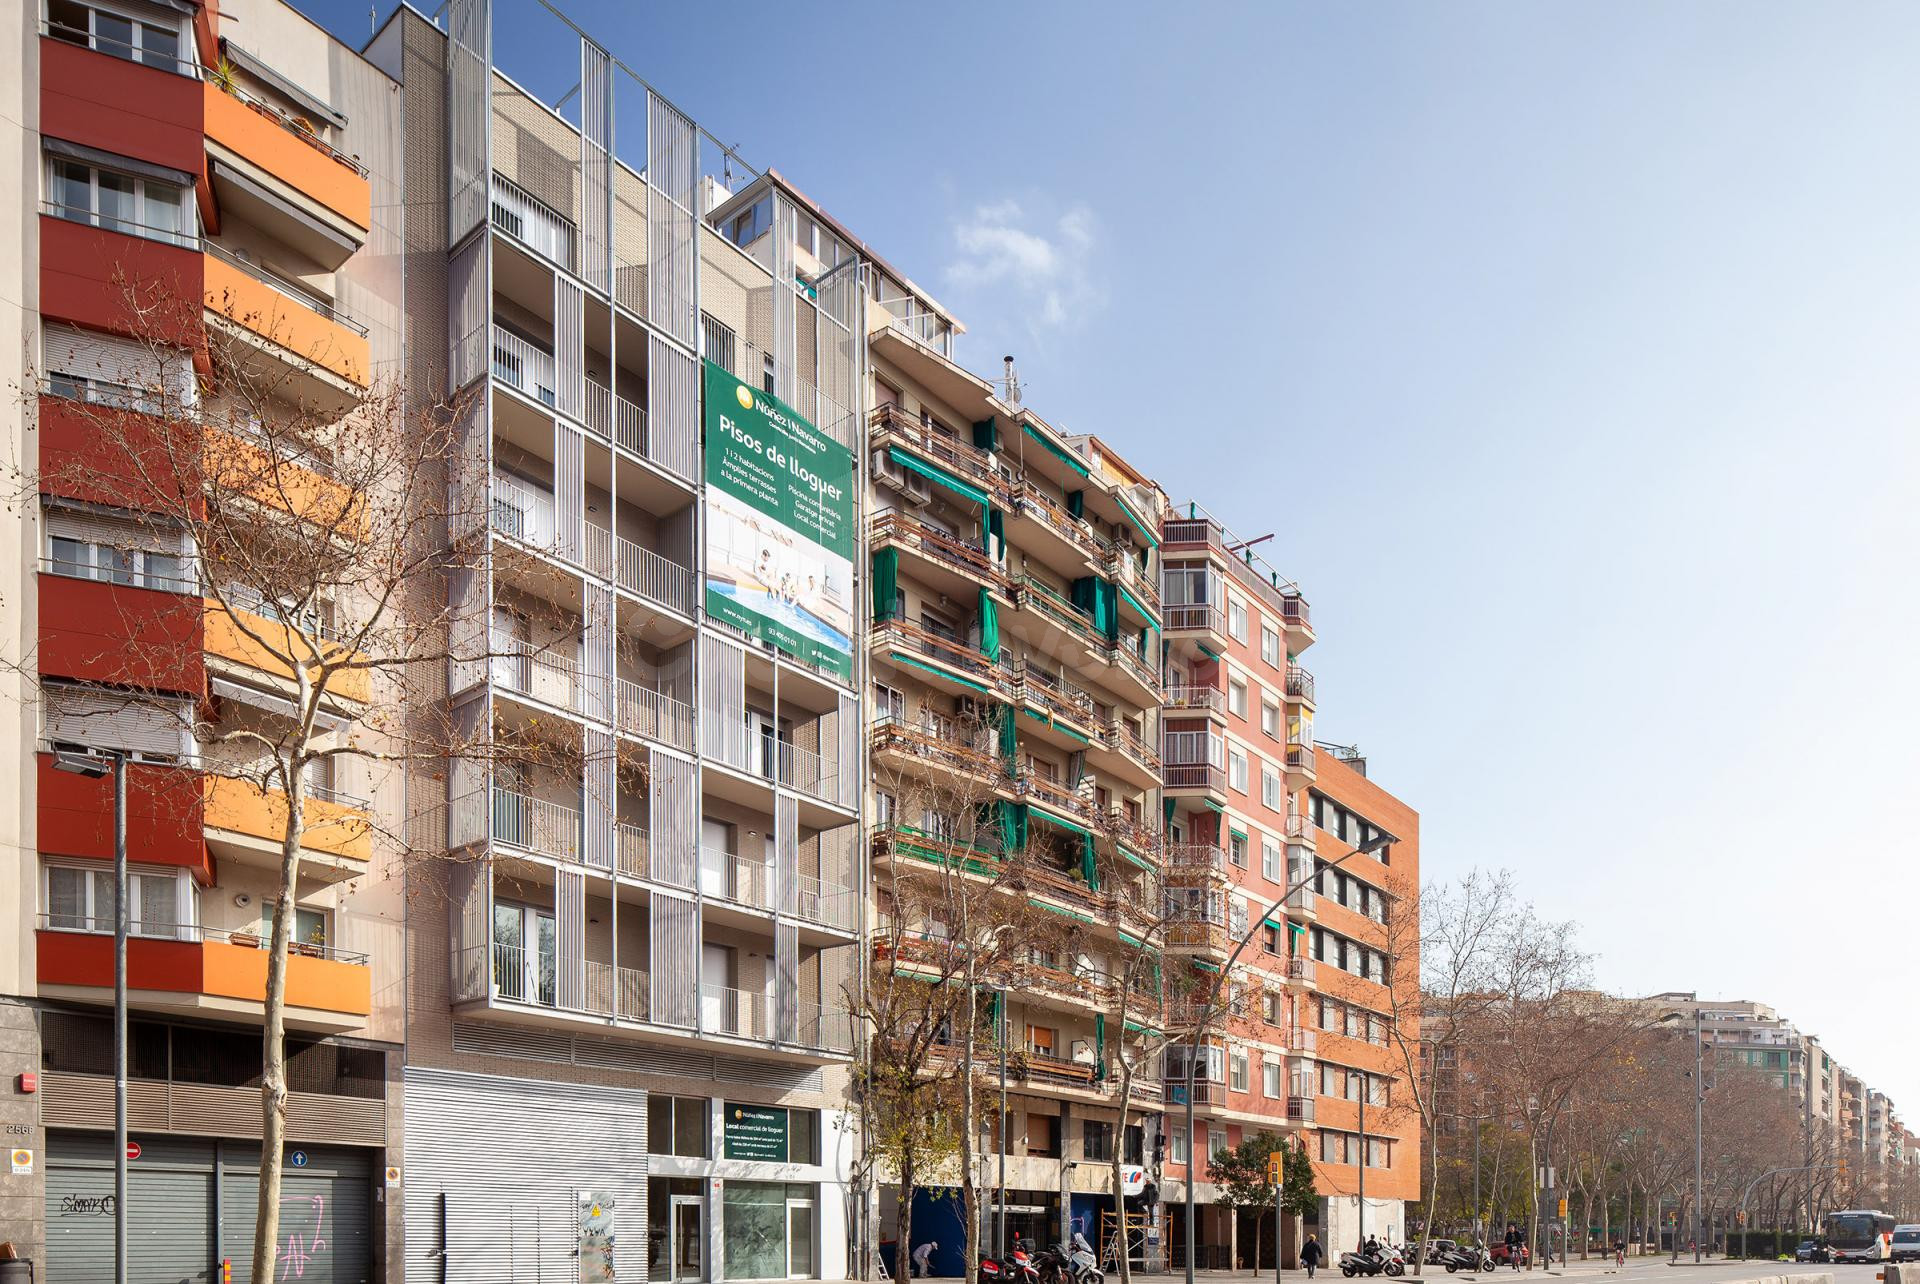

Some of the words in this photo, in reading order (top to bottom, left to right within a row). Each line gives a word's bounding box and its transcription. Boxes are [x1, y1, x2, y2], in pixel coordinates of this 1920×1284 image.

[755, 399, 786, 426] Núñez
[792, 424, 826, 452] Navarro
[719, 414, 761, 454] Pisos
[767, 446, 786, 468] de
[790, 456, 842, 501] lloguer
[733, 452, 738, 460] 2
[739, 455, 774, 481] habitacions
[726, 471, 732, 481] la
[733, 476, 757, 494] primera
[758, 490, 778, 506] planta
[749, 474, 776, 493] terrasses
[788, 485, 807, 499] Piscina
[793, 510, 808, 523] Local
[796, 500, 817, 518] Garatge
